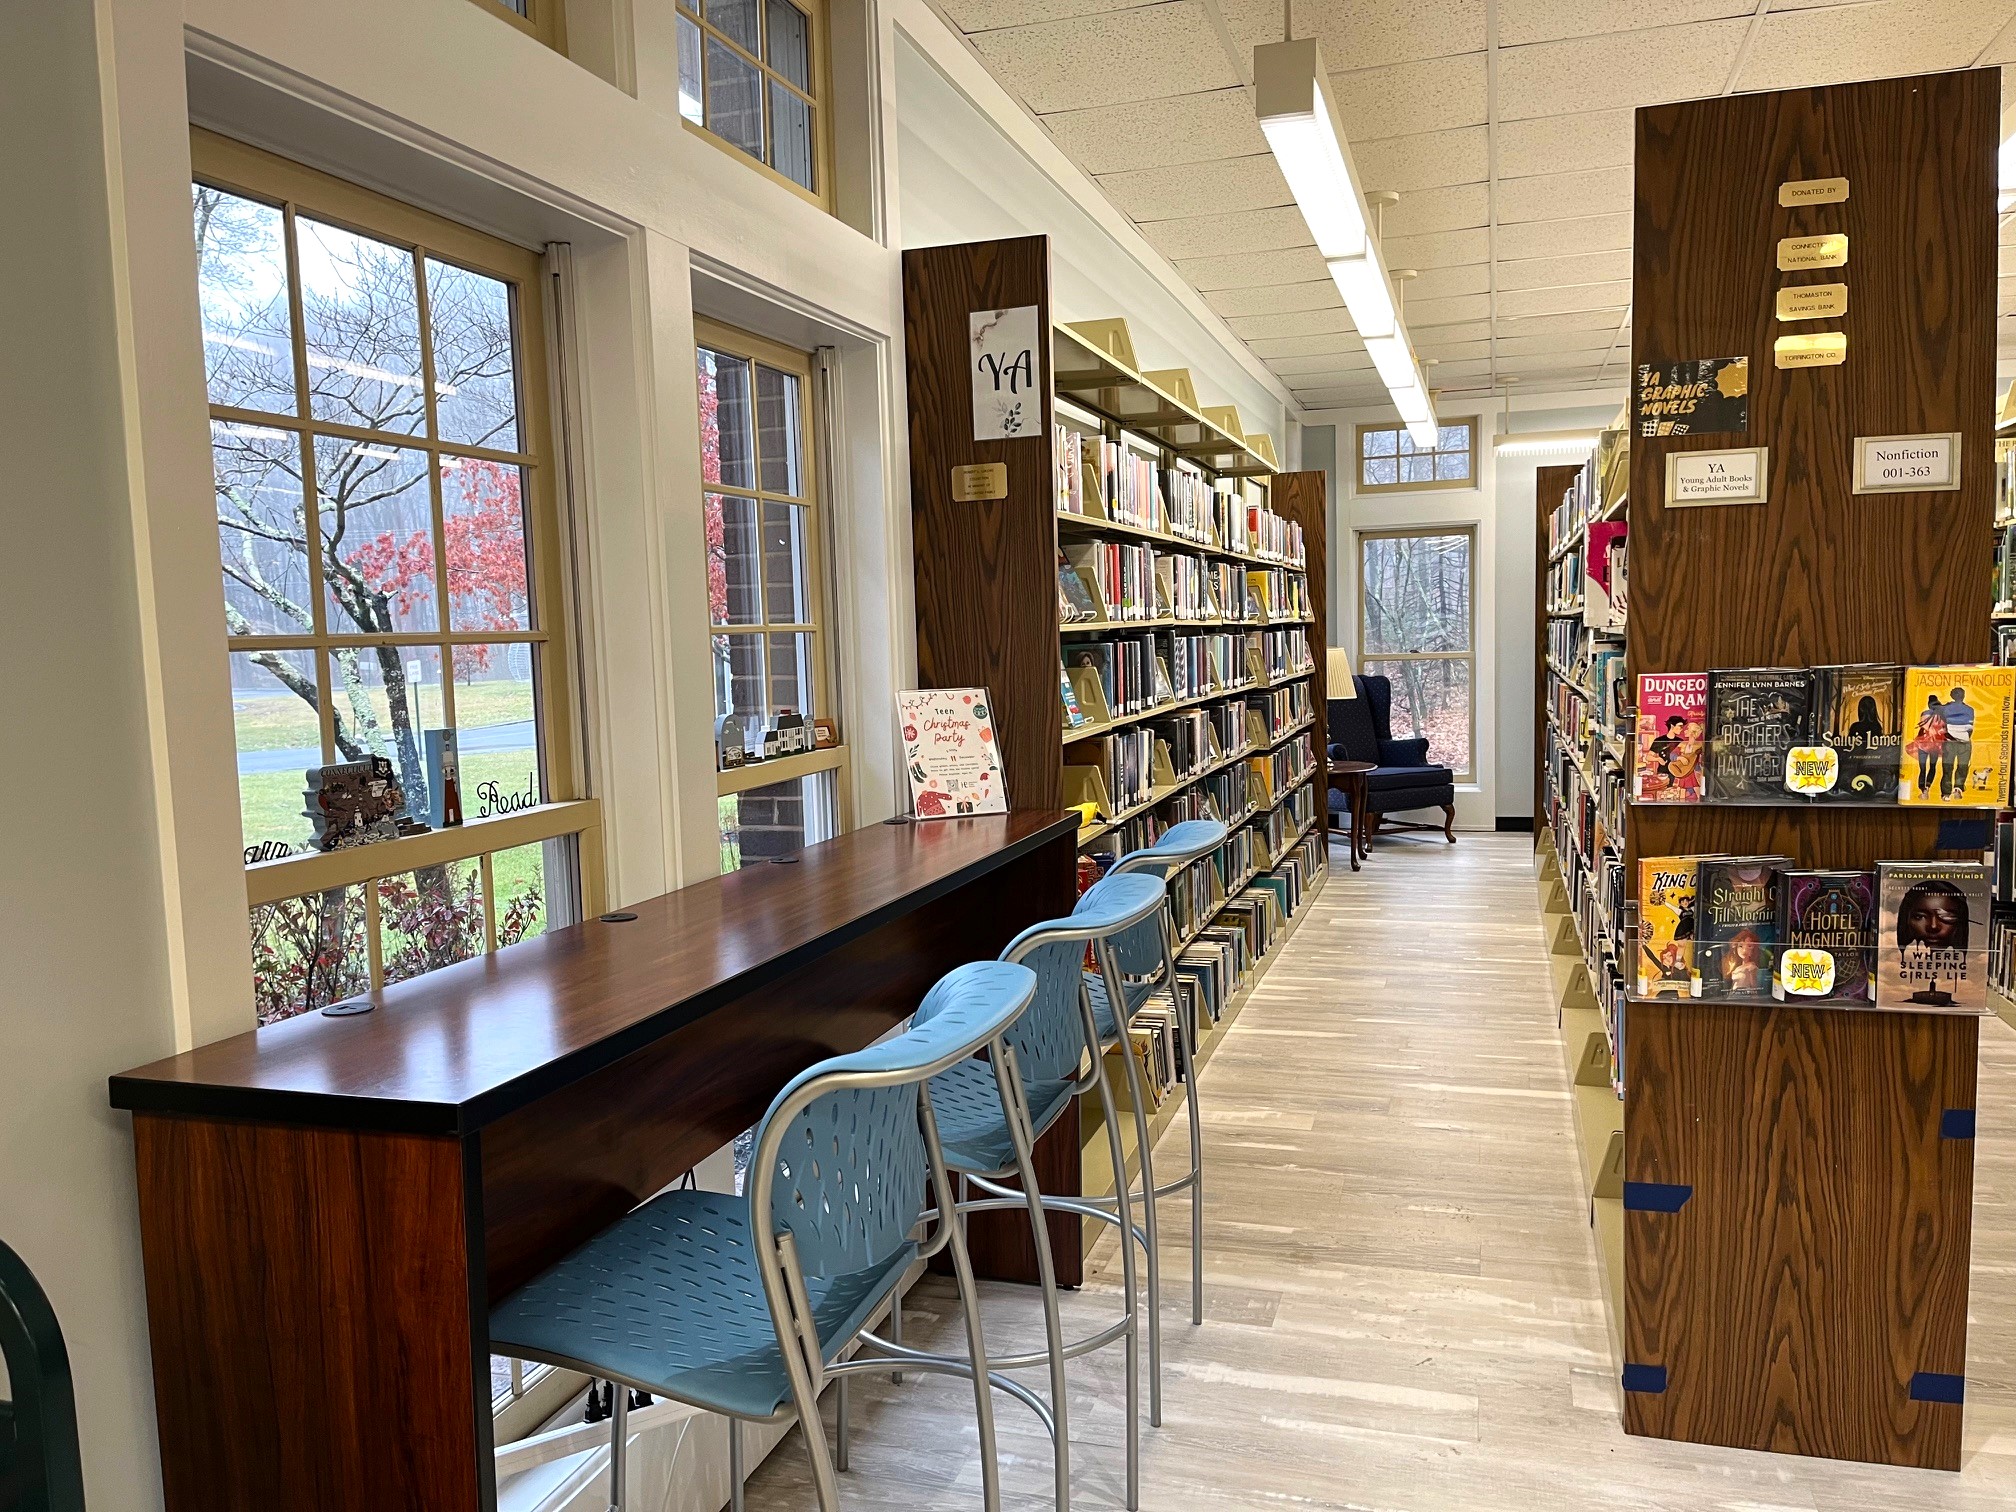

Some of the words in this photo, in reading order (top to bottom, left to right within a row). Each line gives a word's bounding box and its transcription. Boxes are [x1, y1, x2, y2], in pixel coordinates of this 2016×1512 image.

[1791, 188, 1824, 197] DONATED
[1793, 291, 1832, 299] THOMASTON
[1789, 304, 1816, 312] SAVINGS
[1784, 353, 1824, 361] TORRINGTON
[977, 350, 1032, 394] YA
[1642, 372, 1661, 386] YA
[1641, 383, 1709, 401] GRAPHIC
[1641, 399, 1698, 415] NOVELS
[1876, 448, 1939, 462] Nonfiction
[1707, 463, 1725, 474] YA
[1882, 466, 1932, 479] 001-363
[1680, 477, 1705, 485] Young
[1691, 484, 1721, 494] Graphic
[1723, 483, 1749, 491] Novels
[1645, 678, 1707, 692] DUNGEO
[1714, 681, 1751, 689] JENNIFER
[1774, 680, 1805, 688] BARNES
[1914, 675, 1951, 687] JASON
[1954, 674, 2013, 687] REYNOLDS
[1728, 695, 1757, 717] THE
[923, 716, 971, 731] Christmas
[2001, 710, 2010, 729] from
[934, 730, 965, 747] Party
[1722, 722, 1791, 750] BROTHERS
[1822, 731, 1863, 752] Sally's
[1999, 730, 2009, 761] Seconds
[1717, 753, 1786, 777] HAWTHOR
[1795, 761, 1829, 776] NEW
[1997, 763, 2007, 803] Twenty-four
[476, 771, 537, 818] Read
[1652, 872, 1688, 892] KING
[1713, 886, 1765, 905] Straight
[1708, 906, 1730, 925] Till
[1810, 912, 1856, 931] HOTEL
[1913, 951, 1960, 961] WHERE
[1791, 963, 1826, 979] NEW
[1900, 961, 1967, 971] SLEEPING
[1900, 971, 1938, 981] GIRLS
[1947, 971, 1967, 981] LIE
